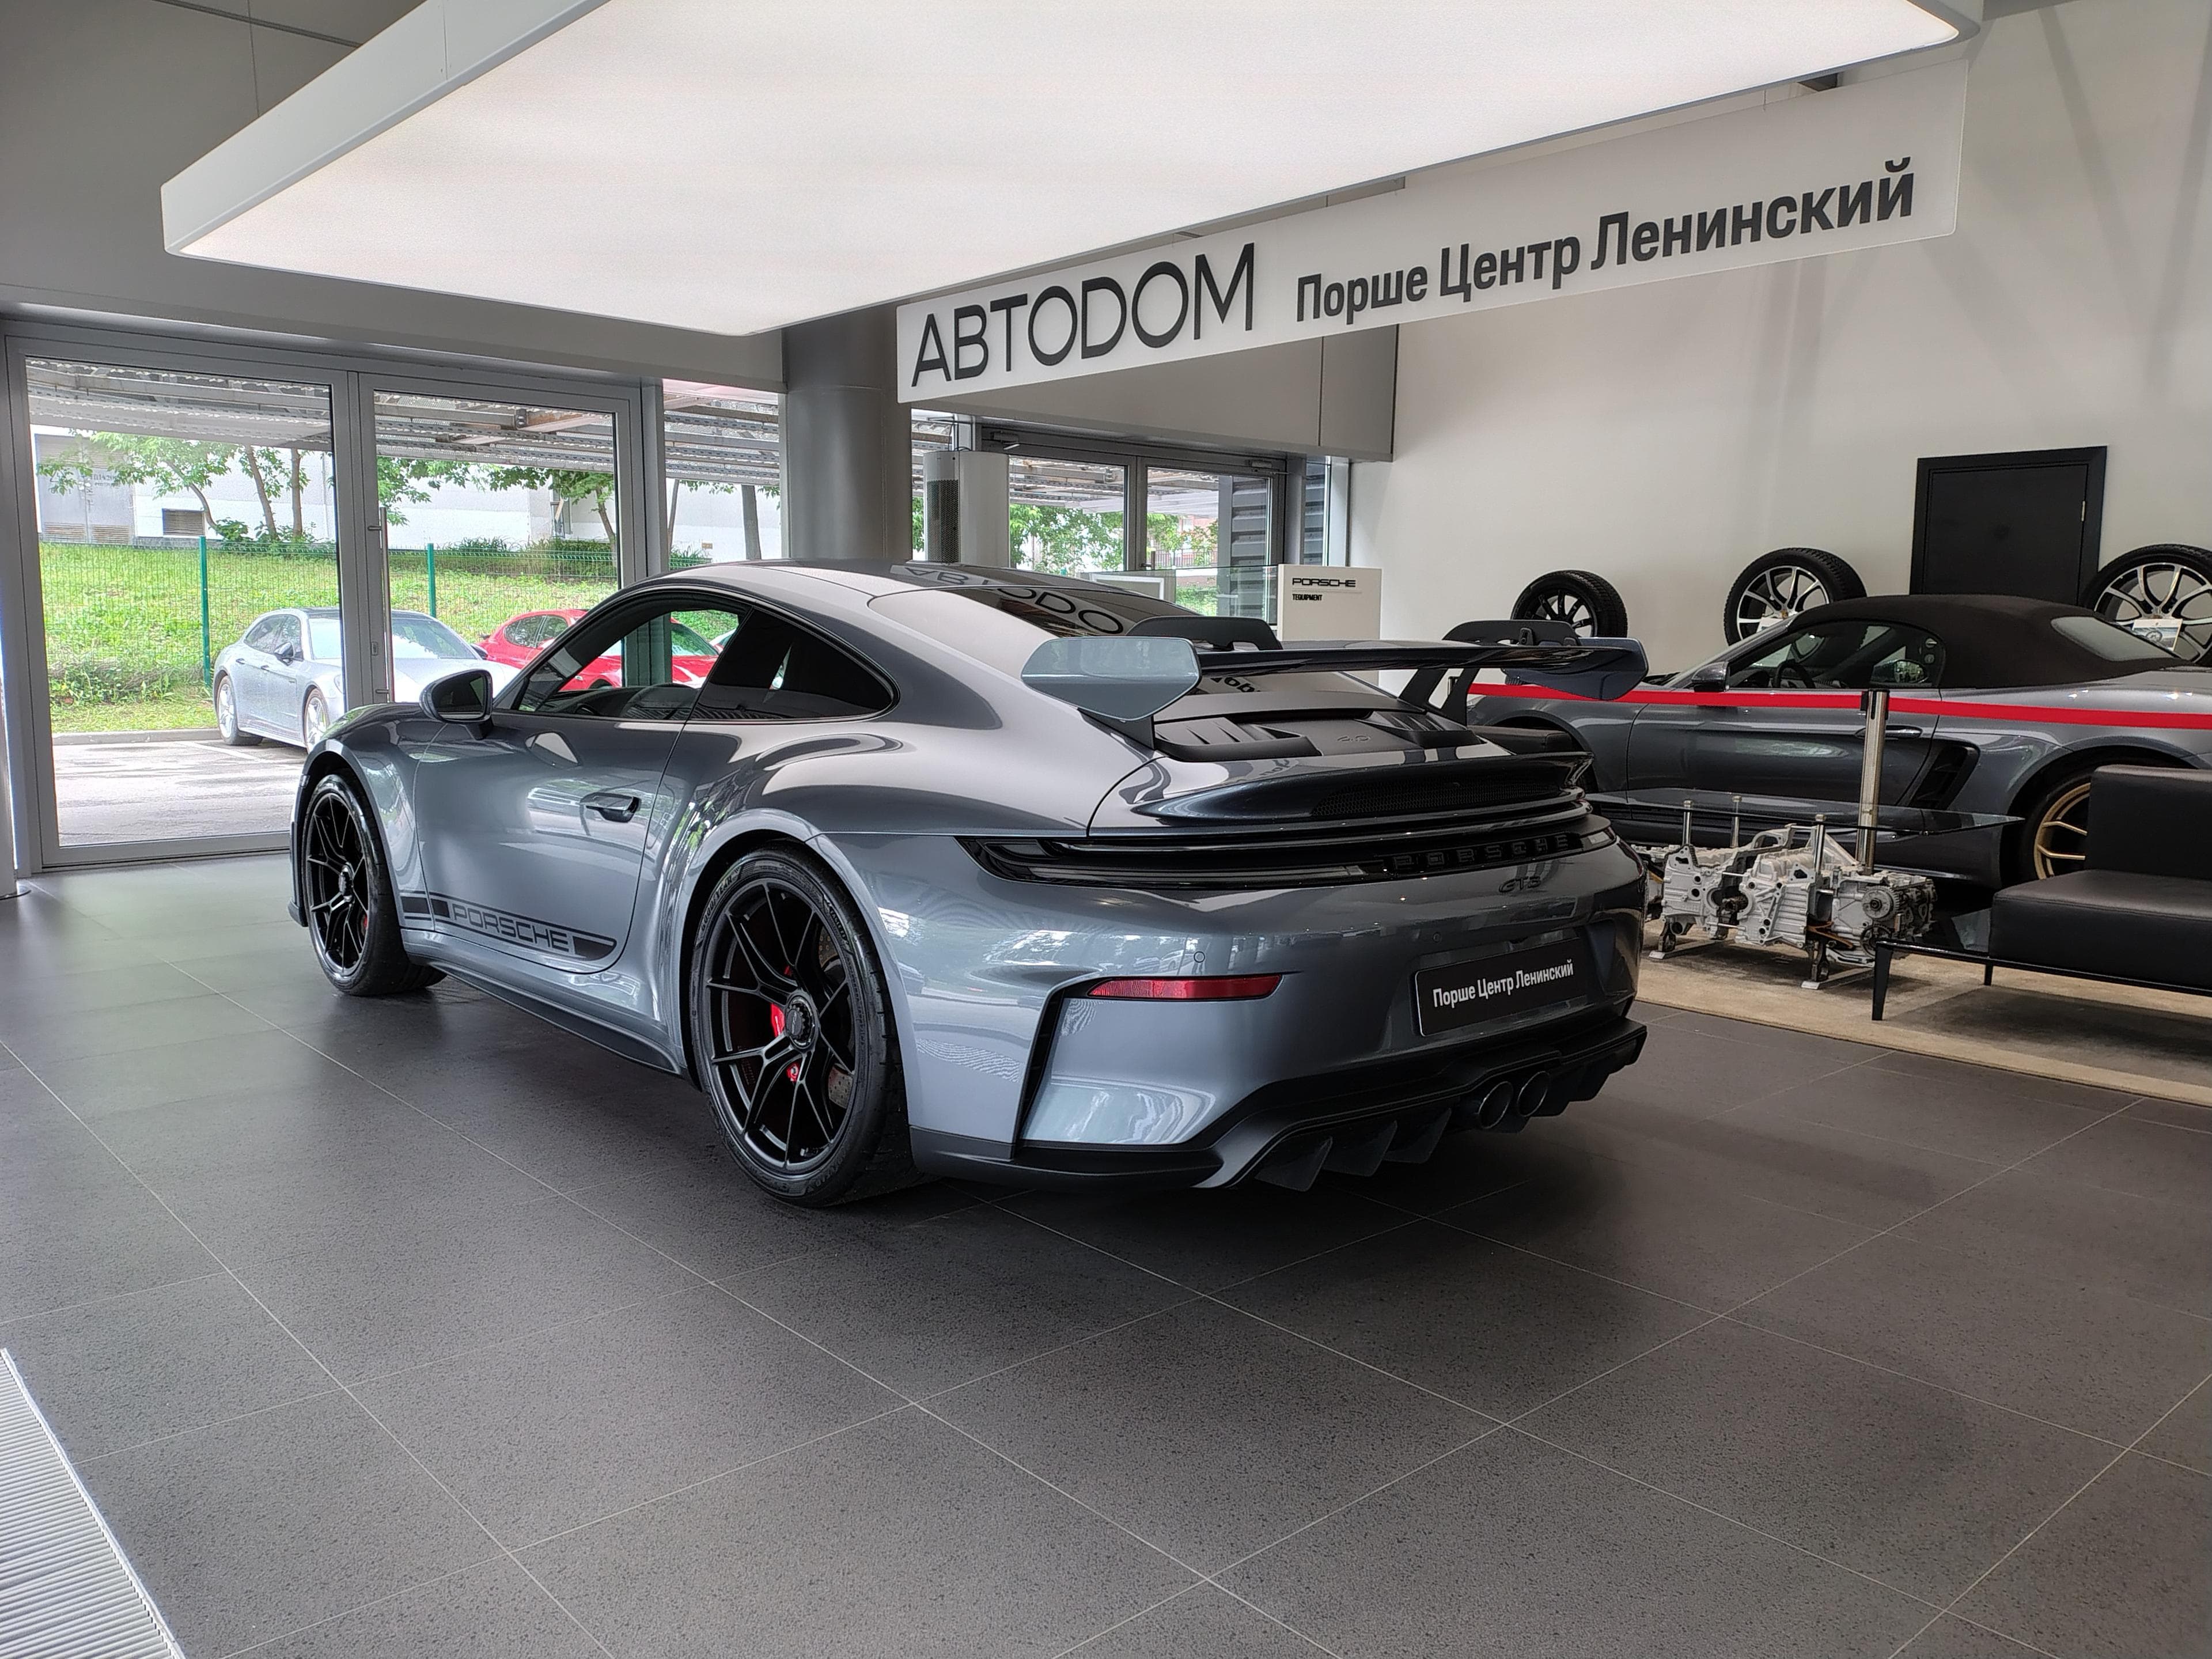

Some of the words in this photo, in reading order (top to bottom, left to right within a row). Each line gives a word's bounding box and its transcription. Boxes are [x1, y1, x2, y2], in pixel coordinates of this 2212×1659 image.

[1297, 267, 1427, 324] Порше
[1440, 237, 1580, 302] Центр
[1591, 157, 1914, 270] Ленинский
[1292, 578, 1356, 587] PORSCHE
[1392, 834, 1569, 870] PORSCHE
[1498, 876, 1541, 893] GT3
[452, 903, 570, 952] PORSCHE
[1433, 986, 1476, 1009] Порше
[1477, 978, 1514, 999] Центр
[1516, 959, 1574, 989] Ленинский
